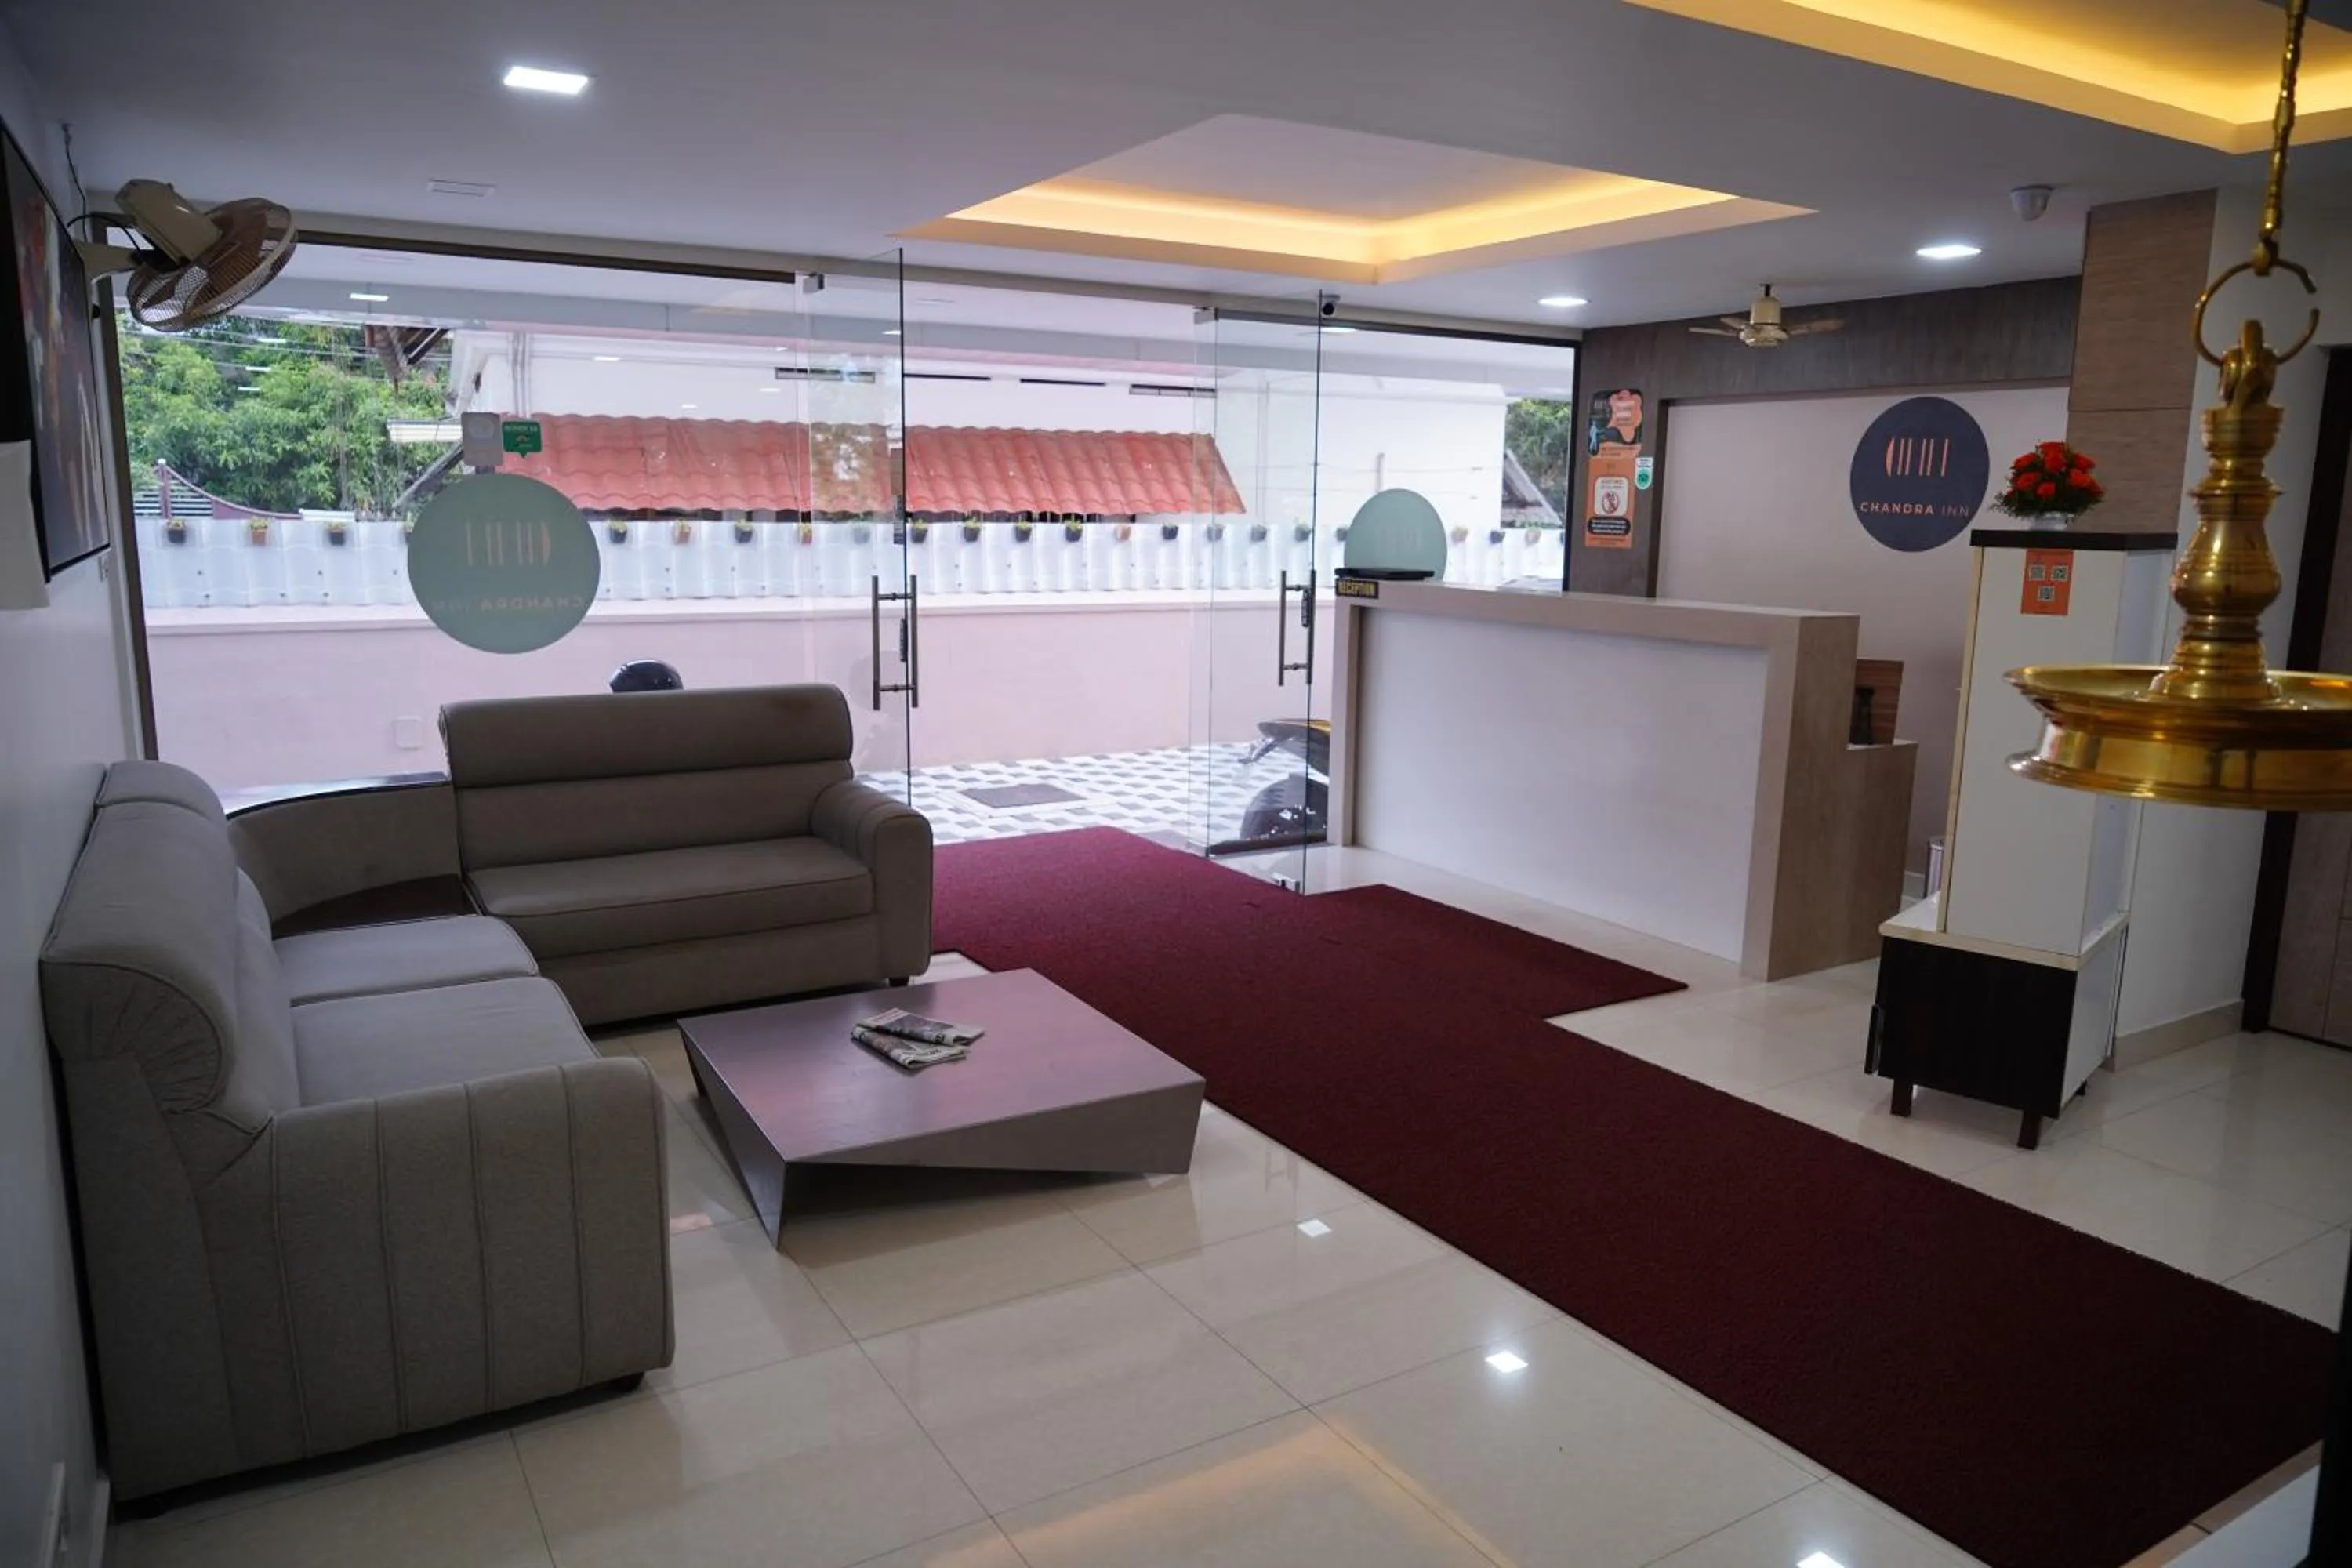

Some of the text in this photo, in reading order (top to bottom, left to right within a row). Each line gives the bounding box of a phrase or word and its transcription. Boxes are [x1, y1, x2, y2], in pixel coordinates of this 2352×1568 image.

[1860, 501, 1970, 517] CHANDRA INN
[1338, 582, 1375, 596] RECEPTION
